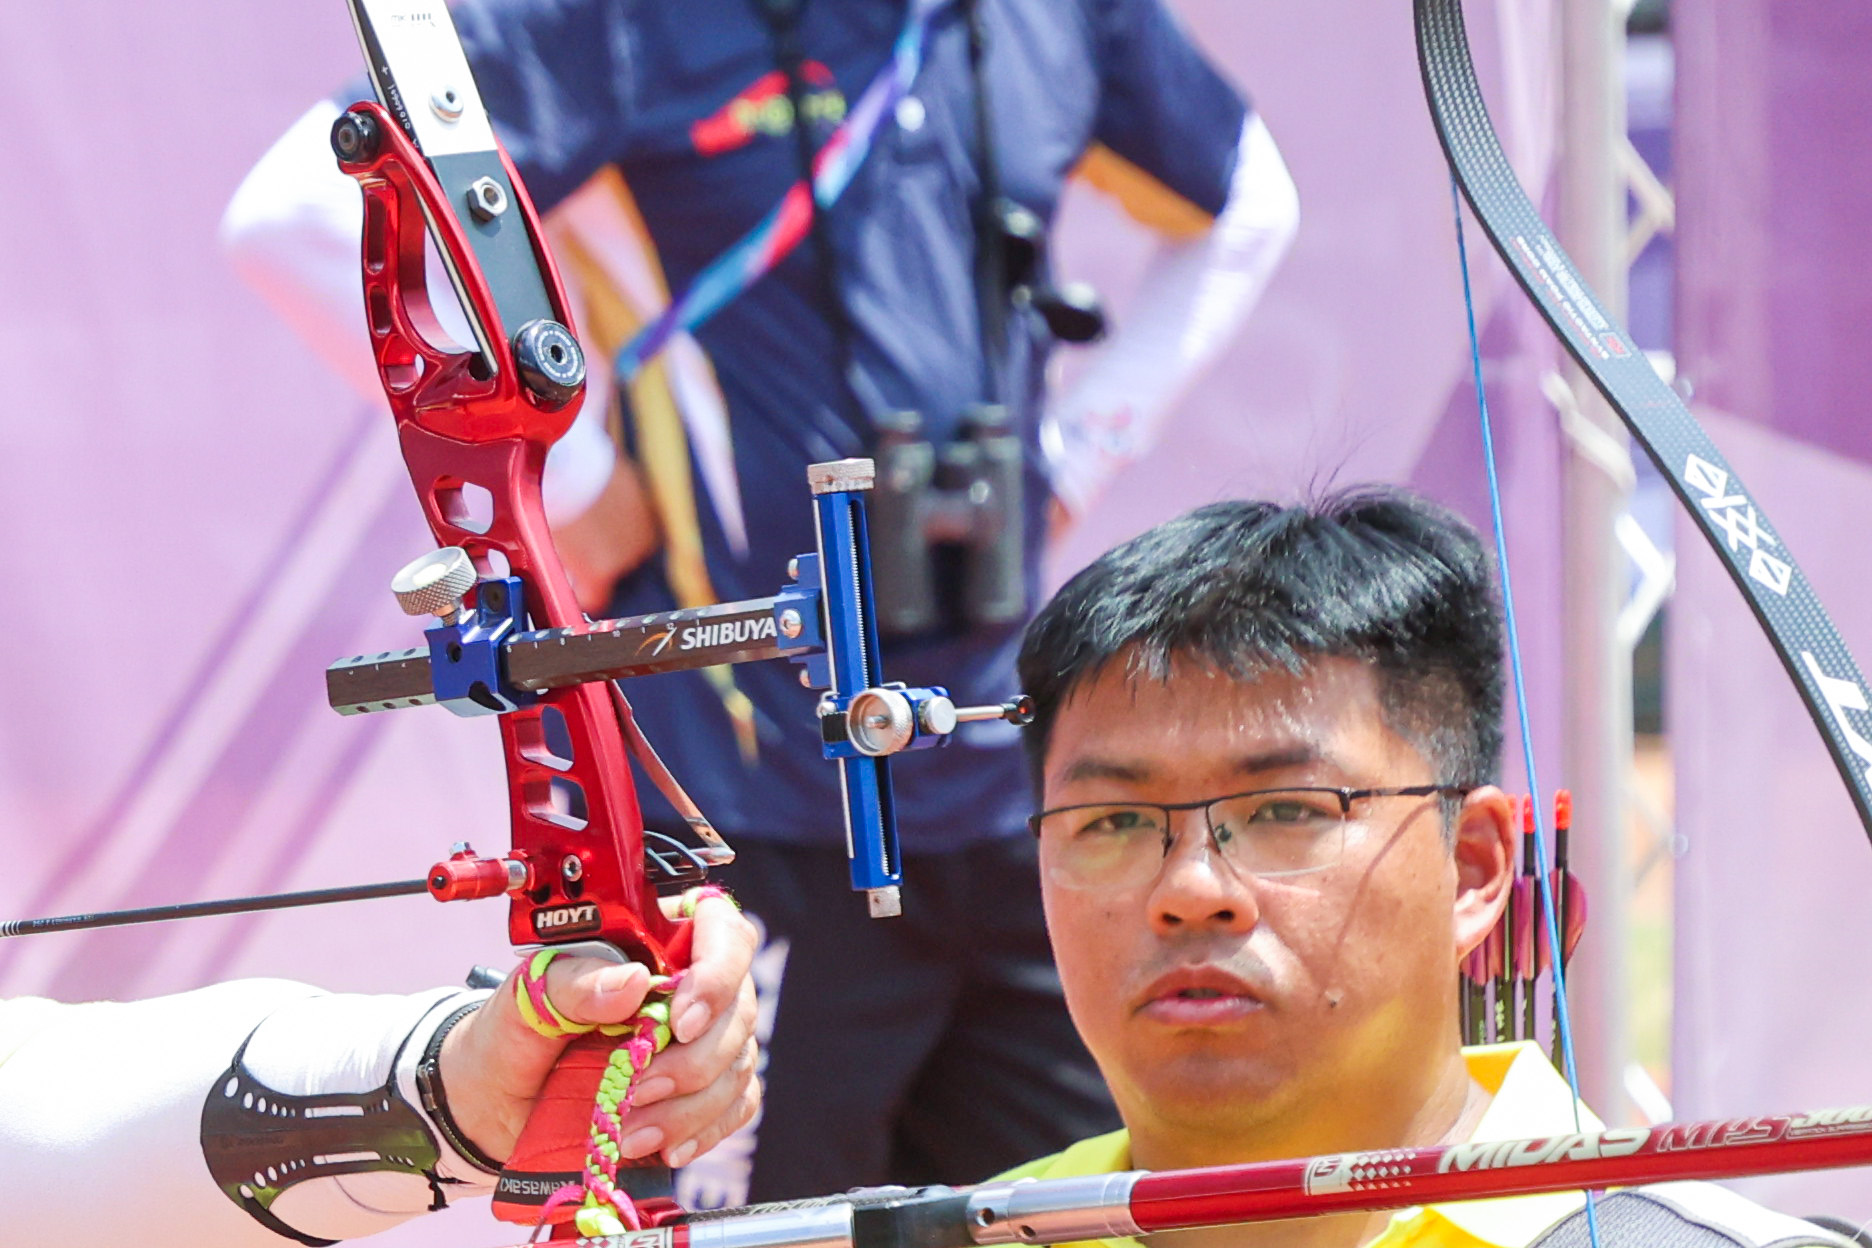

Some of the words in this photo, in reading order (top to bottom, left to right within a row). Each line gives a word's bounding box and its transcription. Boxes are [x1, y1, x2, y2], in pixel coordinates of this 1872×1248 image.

[680, 616, 778, 650] SHIBUYA
[536, 904, 597, 929] HOYT
[1437, 1128, 1652, 1174] MIDAS
[1656, 1115, 1792, 1152] MPS
